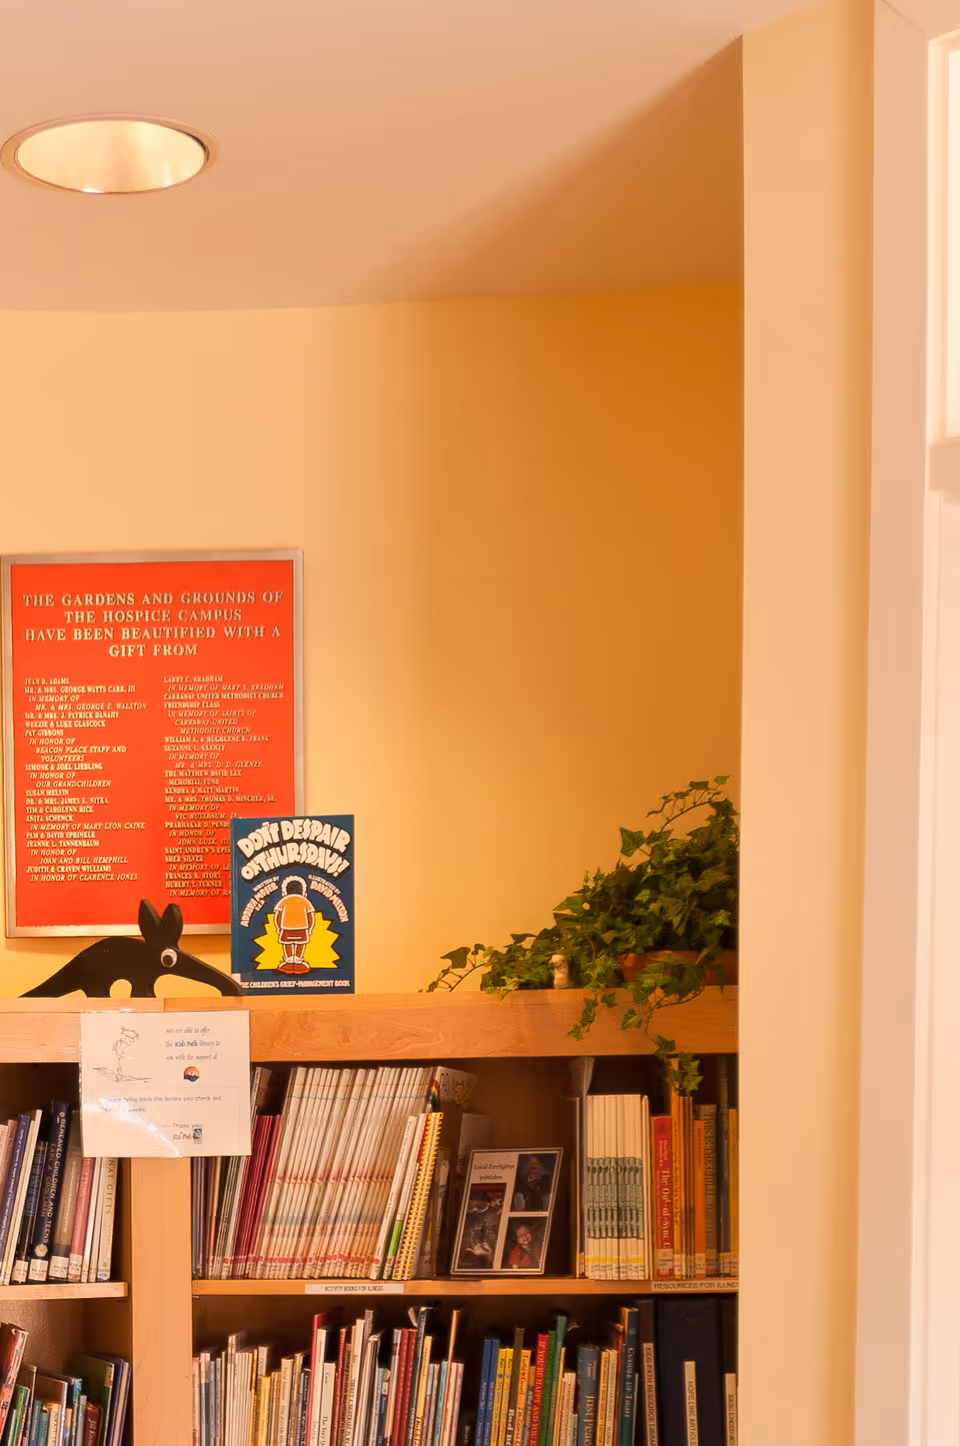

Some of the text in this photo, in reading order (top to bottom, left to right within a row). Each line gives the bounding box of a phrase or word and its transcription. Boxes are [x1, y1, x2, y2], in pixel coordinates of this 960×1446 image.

[23, 591, 283, 606] THE GARDENS AND GROUNDS OF
[65, 609, 242, 623] THE HOSPICE CAMPUS
[25, 626, 281, 641] HAVE BEEN BEAUTIFIED WITH A
[109, 644, 197, 657] GIFT FROM
[237, 818, 351, 858] DON'T DESPAIR
[241, 842, 350, 880] ON THURSDAYS!
[310, 880, 349, 922] DAVID MELTON
[43, 1118, 65, 1244] BEREAVED CHILDREN AND TEENS
